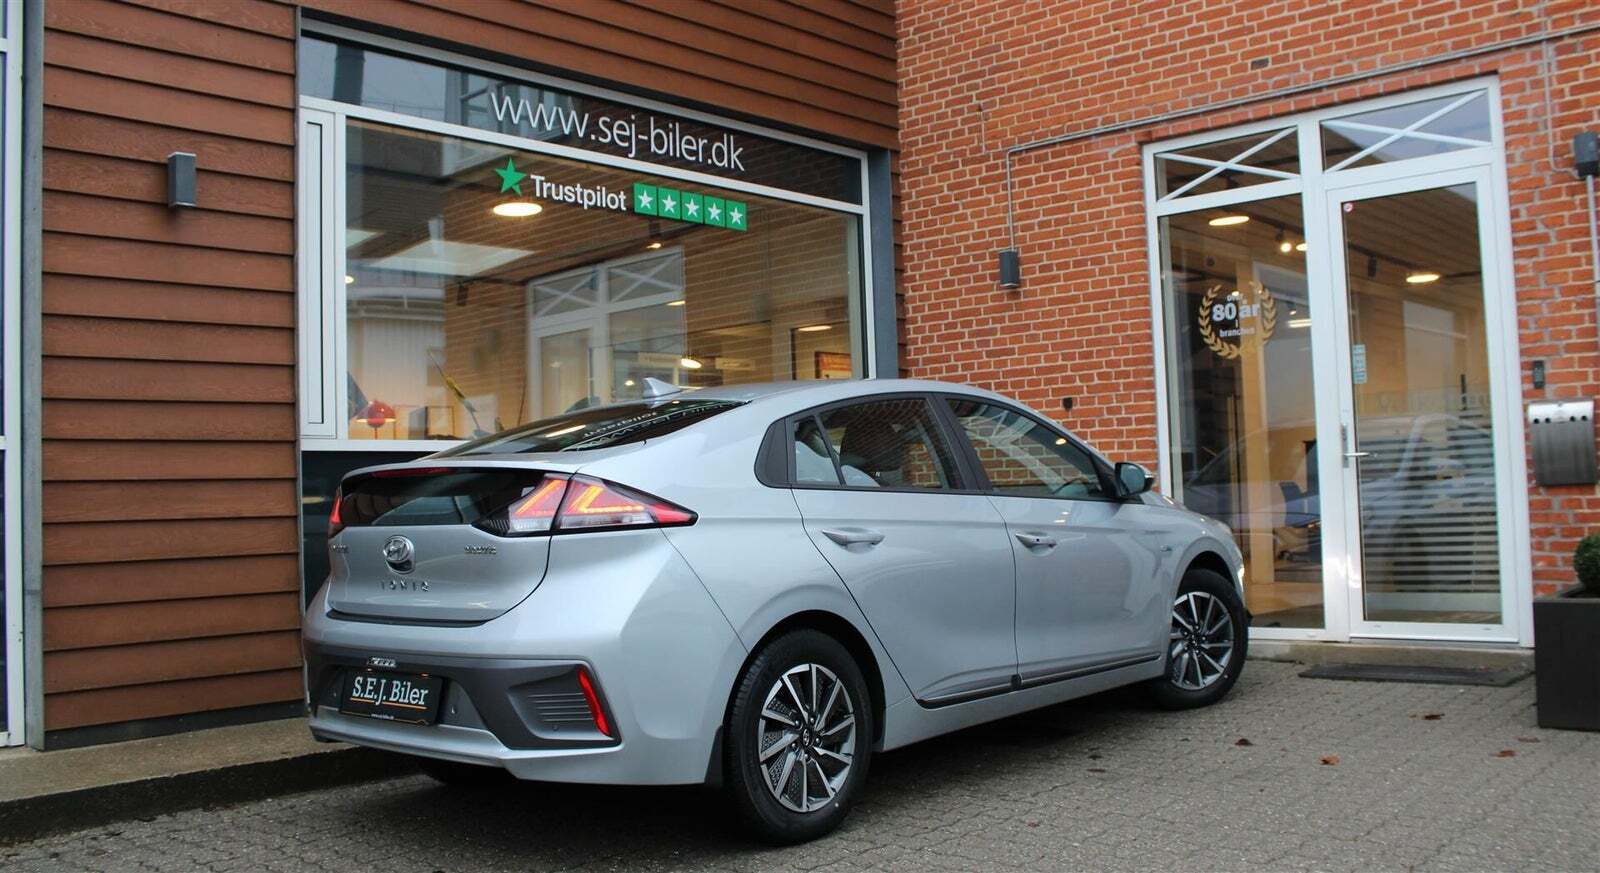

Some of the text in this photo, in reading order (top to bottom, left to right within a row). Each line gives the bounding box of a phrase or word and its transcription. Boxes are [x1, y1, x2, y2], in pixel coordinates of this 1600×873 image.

[490, 92, 745, 172] www.sej-biler.dk
[530, 174, 627, 211] Trustpilot
[1212, 303, 1236, 321] 80
[352, 676, 428, 706] S.E.J. Biler
